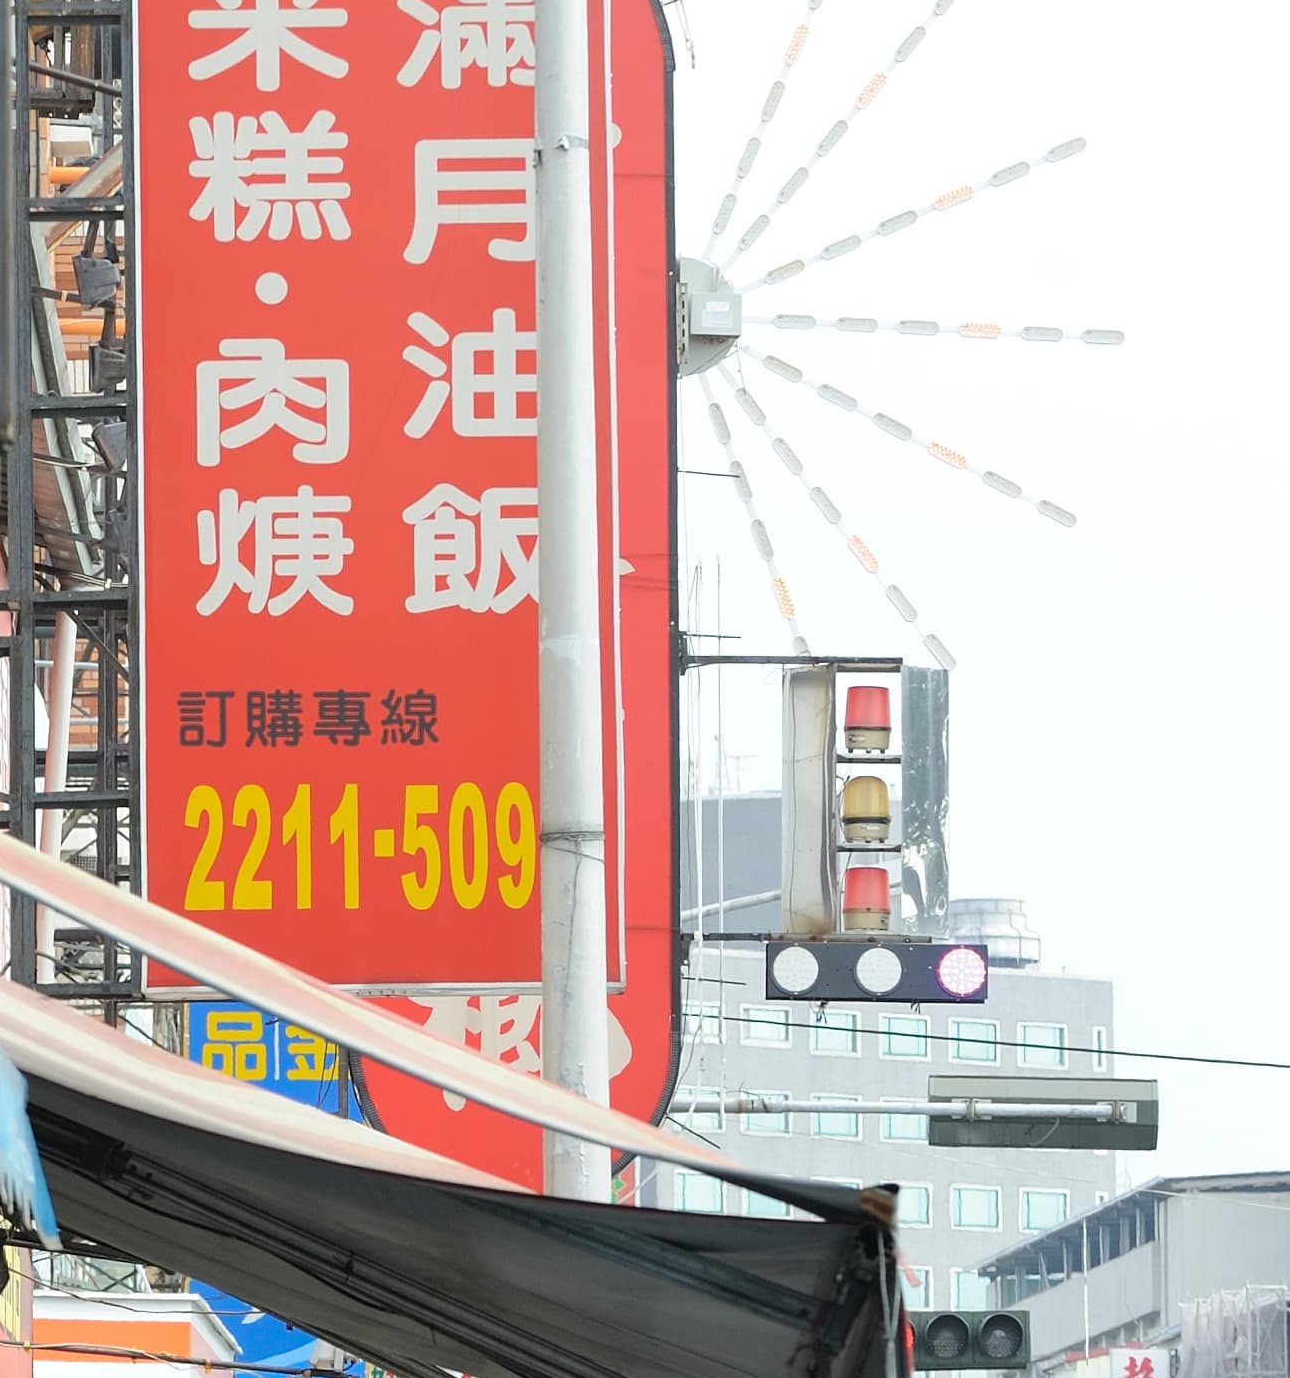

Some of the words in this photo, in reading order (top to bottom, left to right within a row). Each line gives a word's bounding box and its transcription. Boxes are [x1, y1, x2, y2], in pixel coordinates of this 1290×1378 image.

[177, 689, 440, 748] 訂購專線
[183, 782, 537, 911] 2211-509
